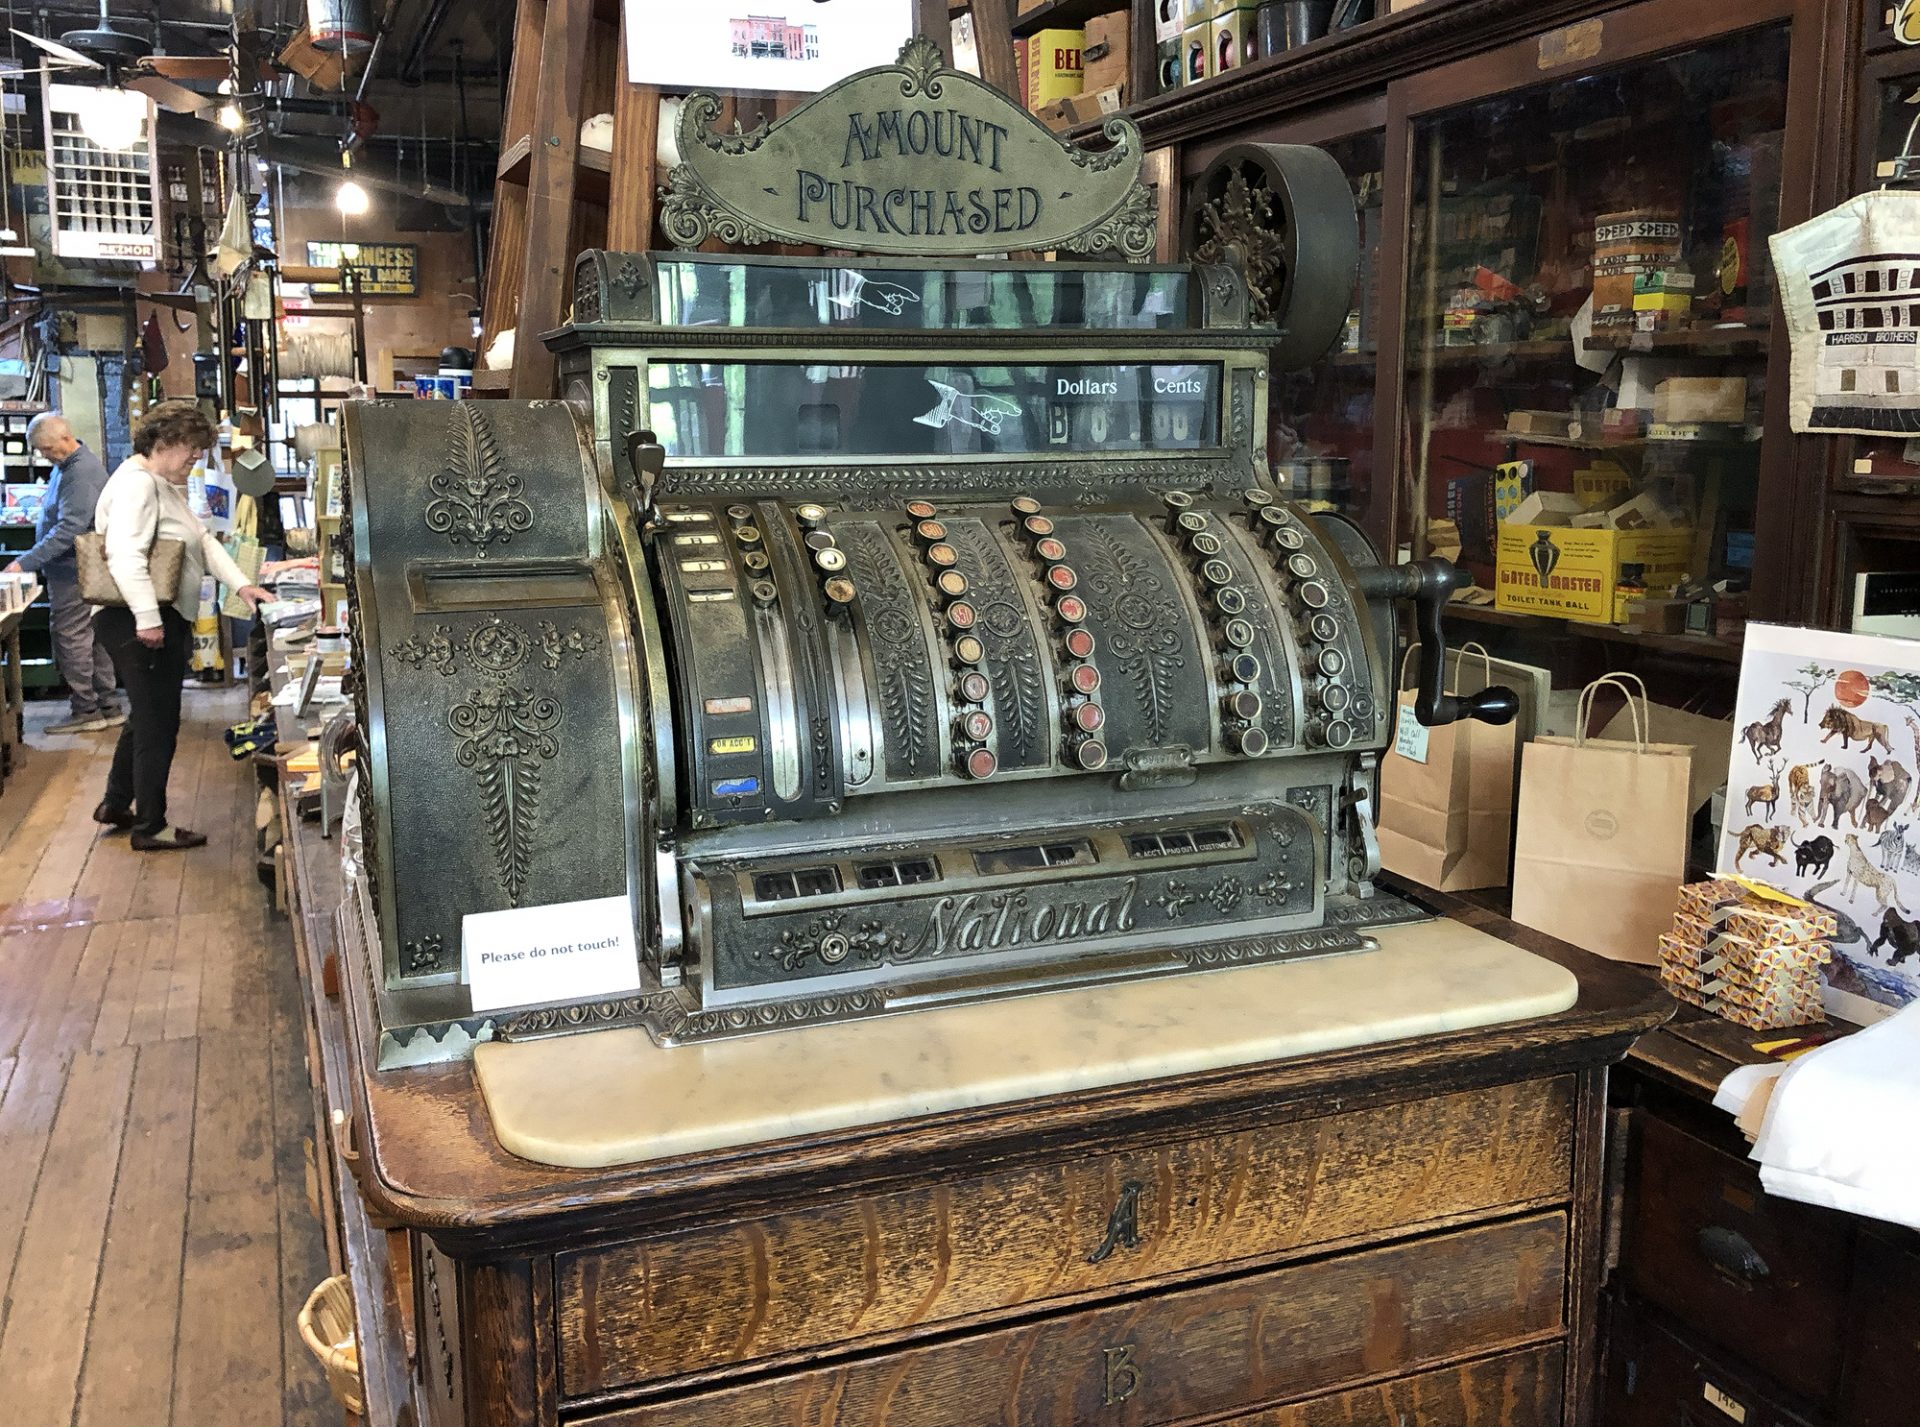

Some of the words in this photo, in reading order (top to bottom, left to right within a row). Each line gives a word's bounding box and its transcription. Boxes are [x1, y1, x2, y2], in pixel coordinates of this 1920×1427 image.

[841, 109, 1009, 173] AMOUNT
[796, 169, 1042, 236] PURCHASED
[1597, 224, 1634, 239] SPEED
[1638, 222, 1678, 236] SPEED
[1875, 331, 1915, 343] BROTHERS
[1057, 379, 1117, 395] Dollars
[1154, 378, 1201, 394] Cents
[1184, 516, 1200, 528] 80
[1199, 537, 1215, 551] 70
[1500, 570, 1538, 587] WATER
[1550, 575, 1601, 593] MASTER
[1507, 594, 1536, 604] TOILET
[1539, 598, 1562, 607] TANK
[1566, 601, 1590, 611] BALL
[1331, 688, 1341, 706] 2
[891, 876, 1138, 957] National
[481, 951, 526, 964] Please
[530, 946, 547, 958] do
[551, 943, 574, 955] not
[578, 936, 620, 952] touch!
[1086, 1180, 1142, 1264] A
[1103, 1344, 1142, 1406] B
